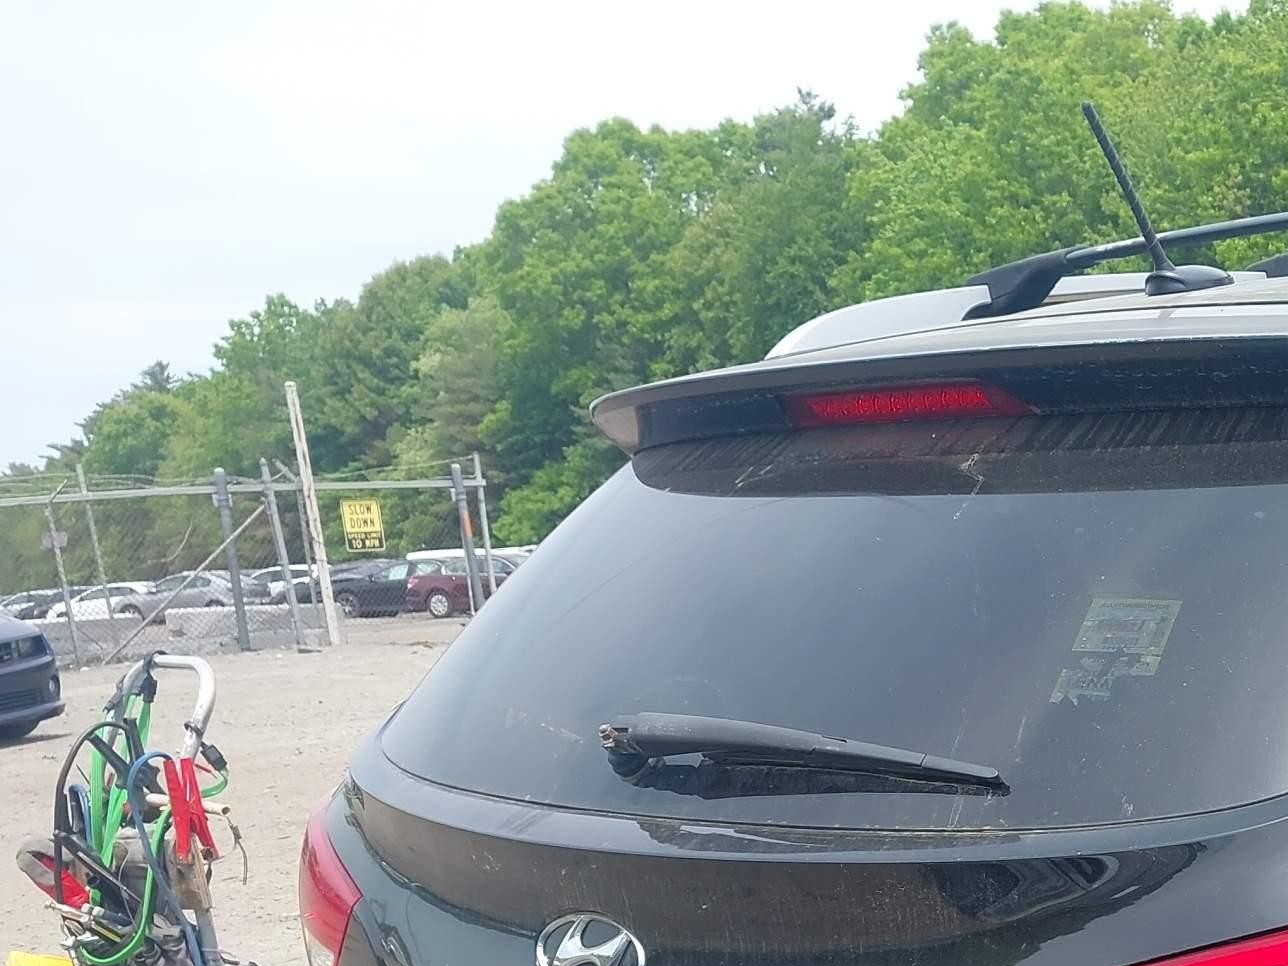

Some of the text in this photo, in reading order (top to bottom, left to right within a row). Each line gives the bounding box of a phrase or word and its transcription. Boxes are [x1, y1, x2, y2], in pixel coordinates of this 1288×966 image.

[348, 503, 372, 515] SLOW
[350, 517, 376, 529] DOWN
[351, 539, 362, 548] 10
